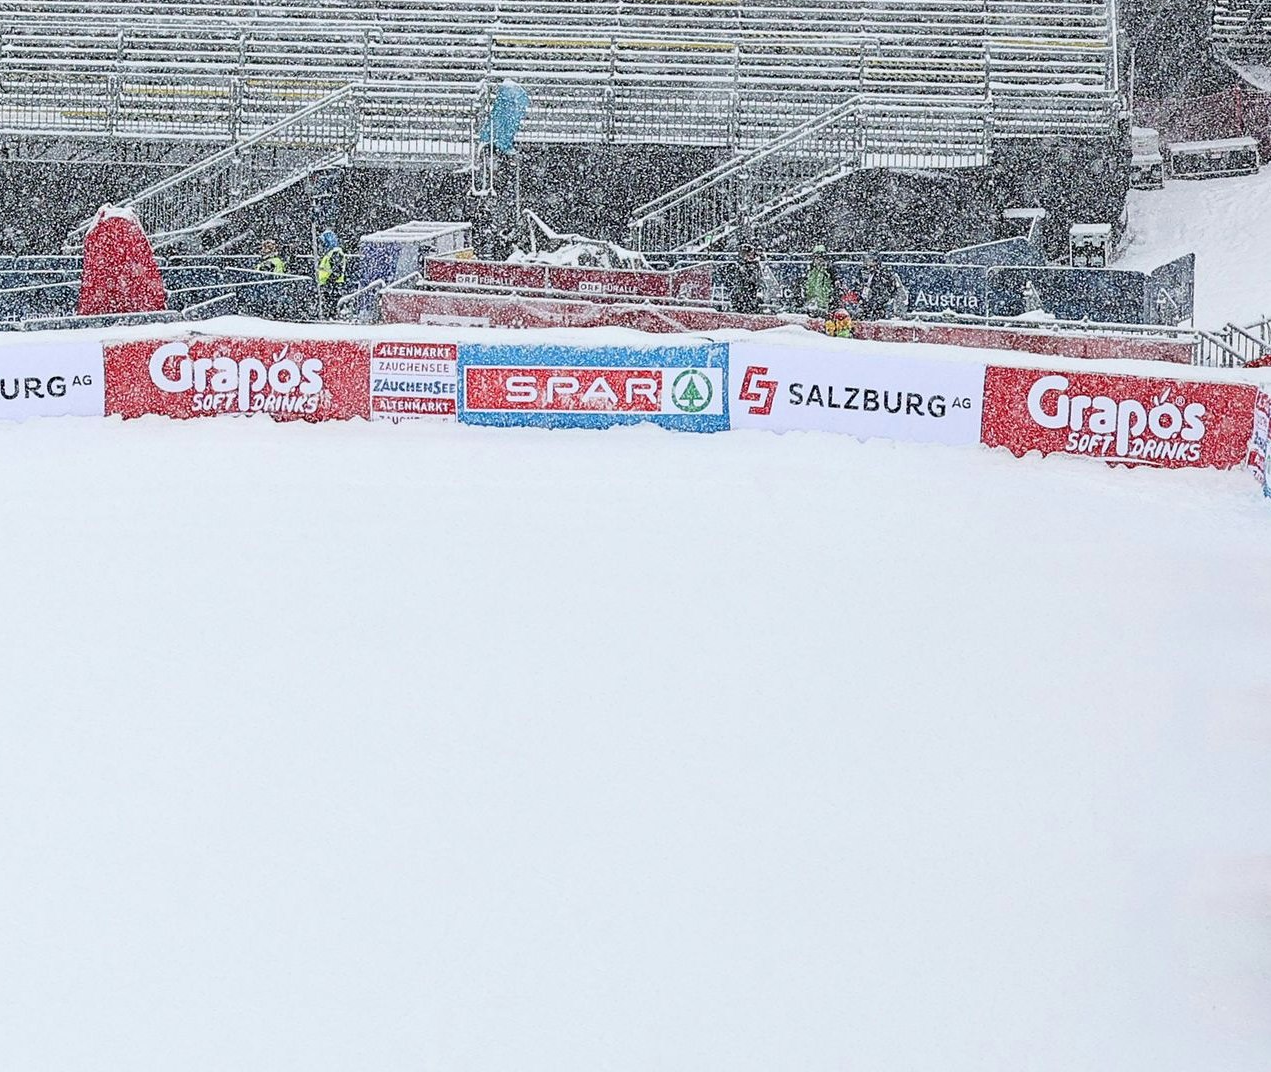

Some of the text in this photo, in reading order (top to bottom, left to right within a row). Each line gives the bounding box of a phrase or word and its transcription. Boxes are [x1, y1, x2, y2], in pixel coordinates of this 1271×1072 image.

[915, 290, 979, 308] Austria
[379, 345, 451, 358] ALTENMARKT
[379, 361, 450, 373] ZAUCHENSEE
[71, 375, 92, 386] AG
[373, 378, 456, 395] ZAUCHENSEE
[505, 375, 659, 404] SPAR
[192, 391, 318, 413] SOFT DRINKS
[379, 399, 450, 413] ALTENMARKT
[789, 382, 972, 418] SALZBURG AG
[1065, 433, 1201, 463] SOFT DRINKS
